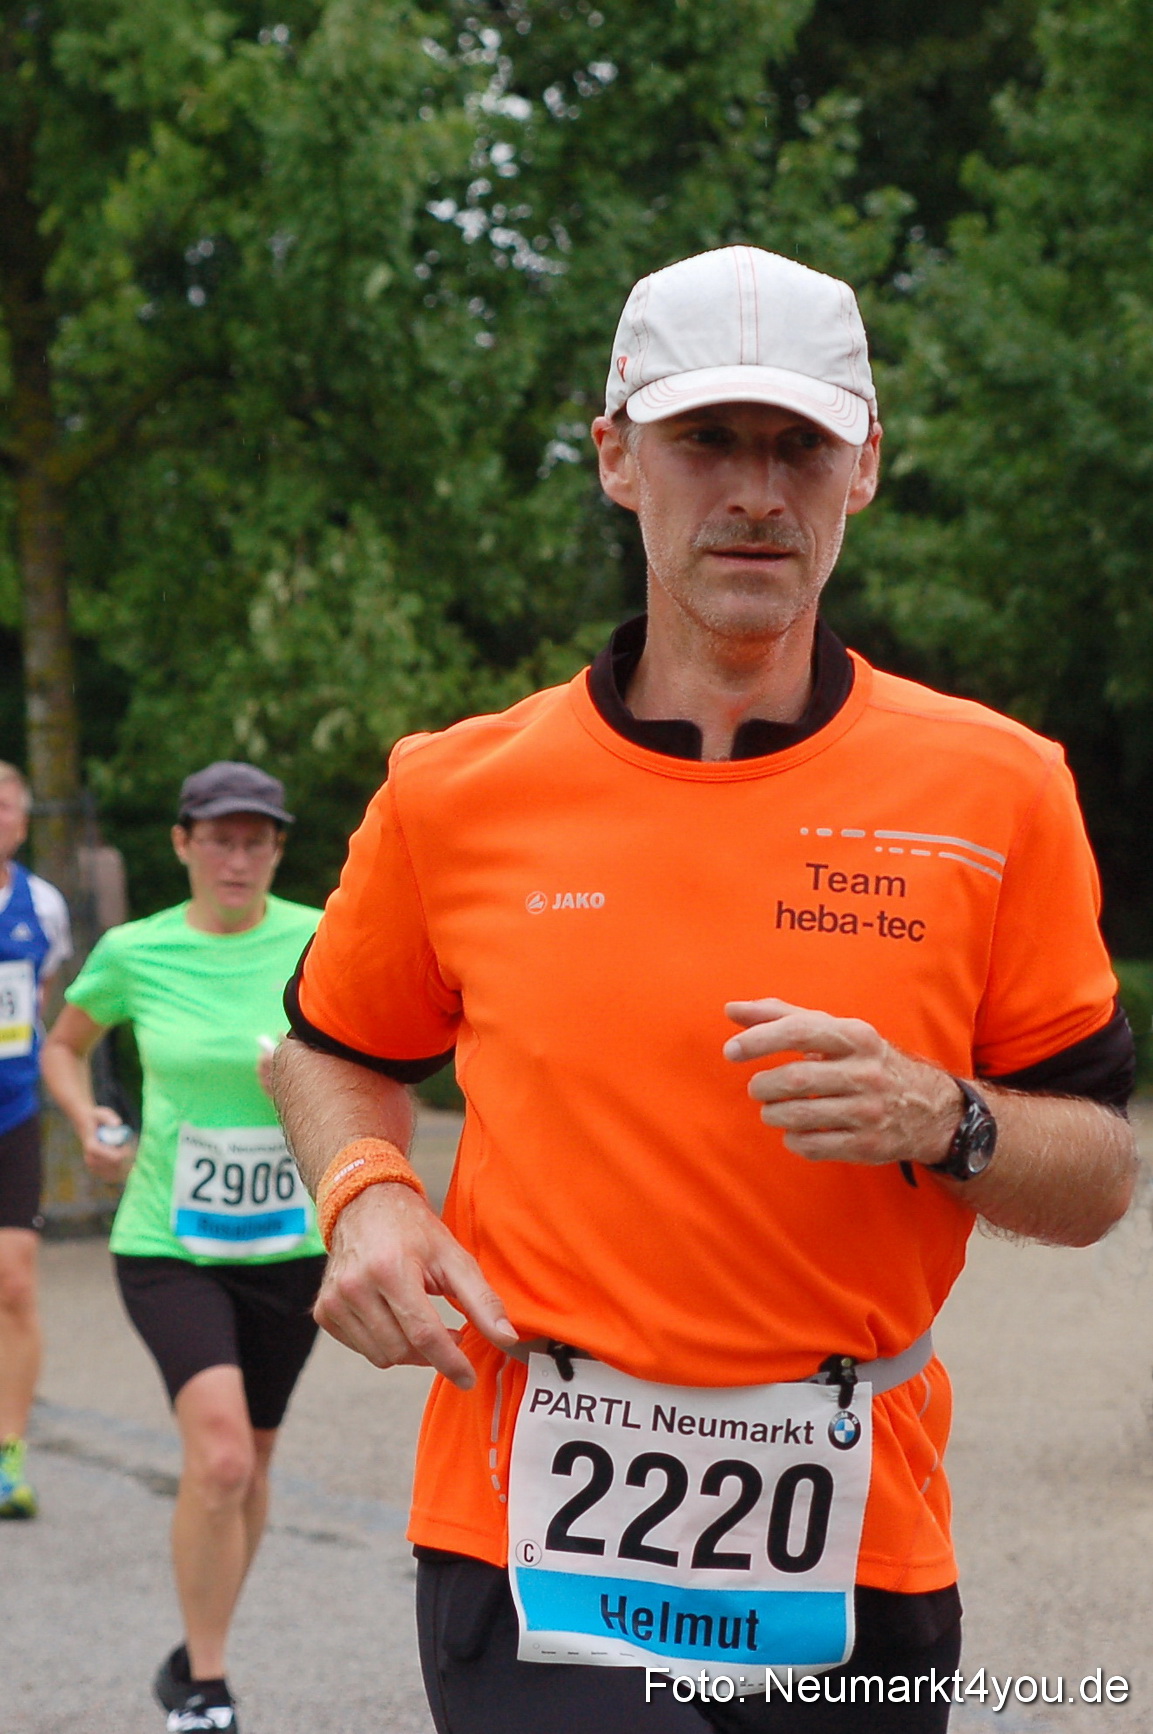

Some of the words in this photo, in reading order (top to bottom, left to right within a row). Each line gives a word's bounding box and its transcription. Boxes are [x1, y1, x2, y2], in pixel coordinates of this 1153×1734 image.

[552, 892, 605, 910] JAKO
[805, 862, 906, 897] Team
[775, 901, 927, 942] heba-tec
[191, 1157, 294, 1206] 2906
[529, 1388, 641, 1430] PARTL
[651, 1405, 814, 1445] Neumarkt
[545, 1440, 834, 1573] 2220
[523, 1543, 534, 1563] C
[600, 1593, 760, 1651] Helmut
